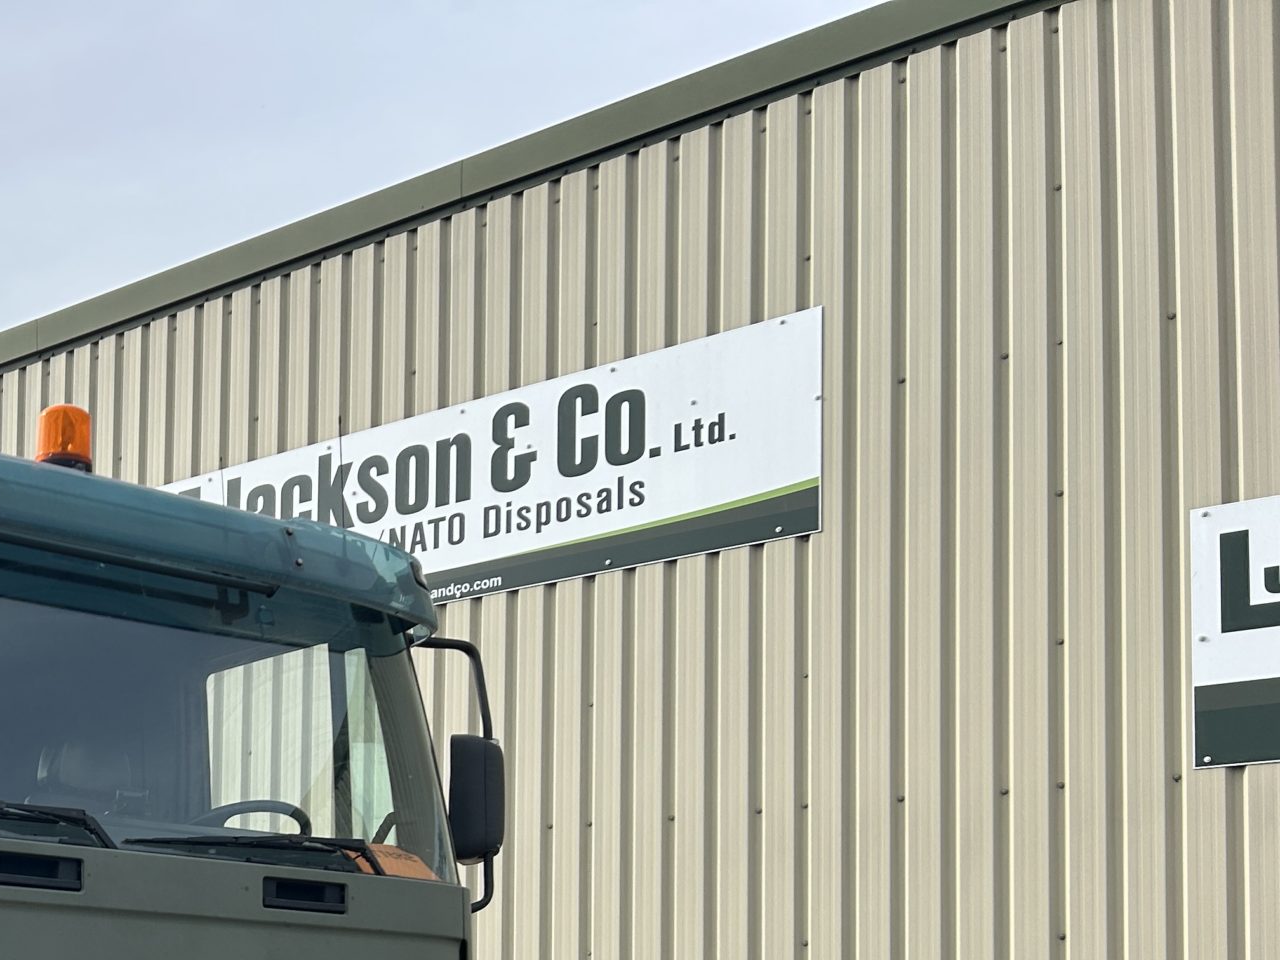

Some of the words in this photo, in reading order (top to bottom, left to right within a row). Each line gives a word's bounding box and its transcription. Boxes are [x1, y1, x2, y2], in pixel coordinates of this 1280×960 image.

[491, 401, 538, 493] &
[557, 383, 662, 477] Co.
[674, 412, 737, 452] Ltd.
[483, 476, 646, 539] Disposals
